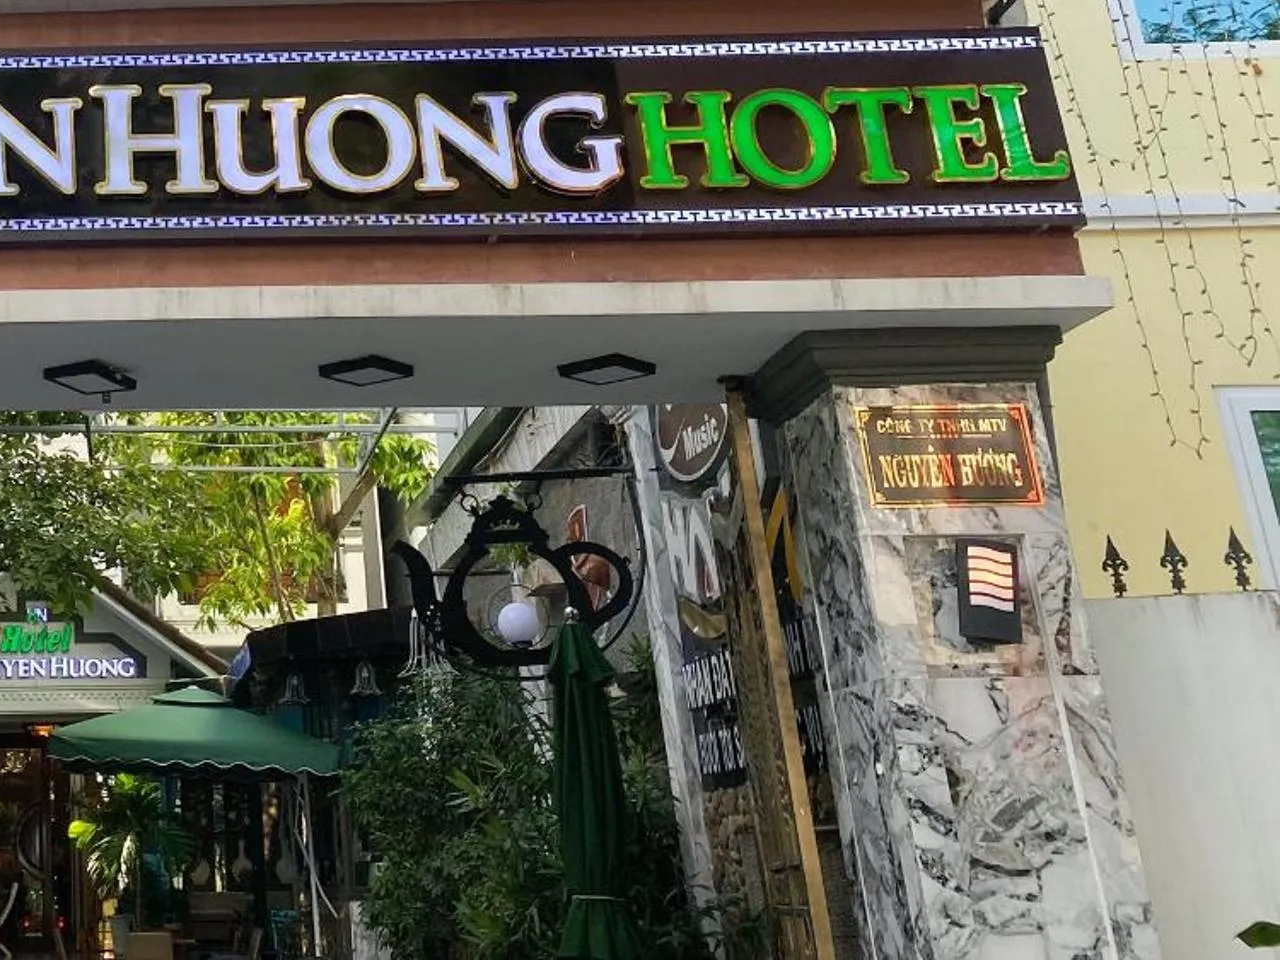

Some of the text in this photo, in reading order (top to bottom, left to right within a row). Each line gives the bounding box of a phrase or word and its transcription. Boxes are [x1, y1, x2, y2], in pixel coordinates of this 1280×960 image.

[625, 84, 1071, 190] HOTEL
[681, 415, 720, 462] Music
[918, 418, 935, 433] TY
[0, 623, 74, 654] Hotel
[50, 655, 136, 678] HUONG
